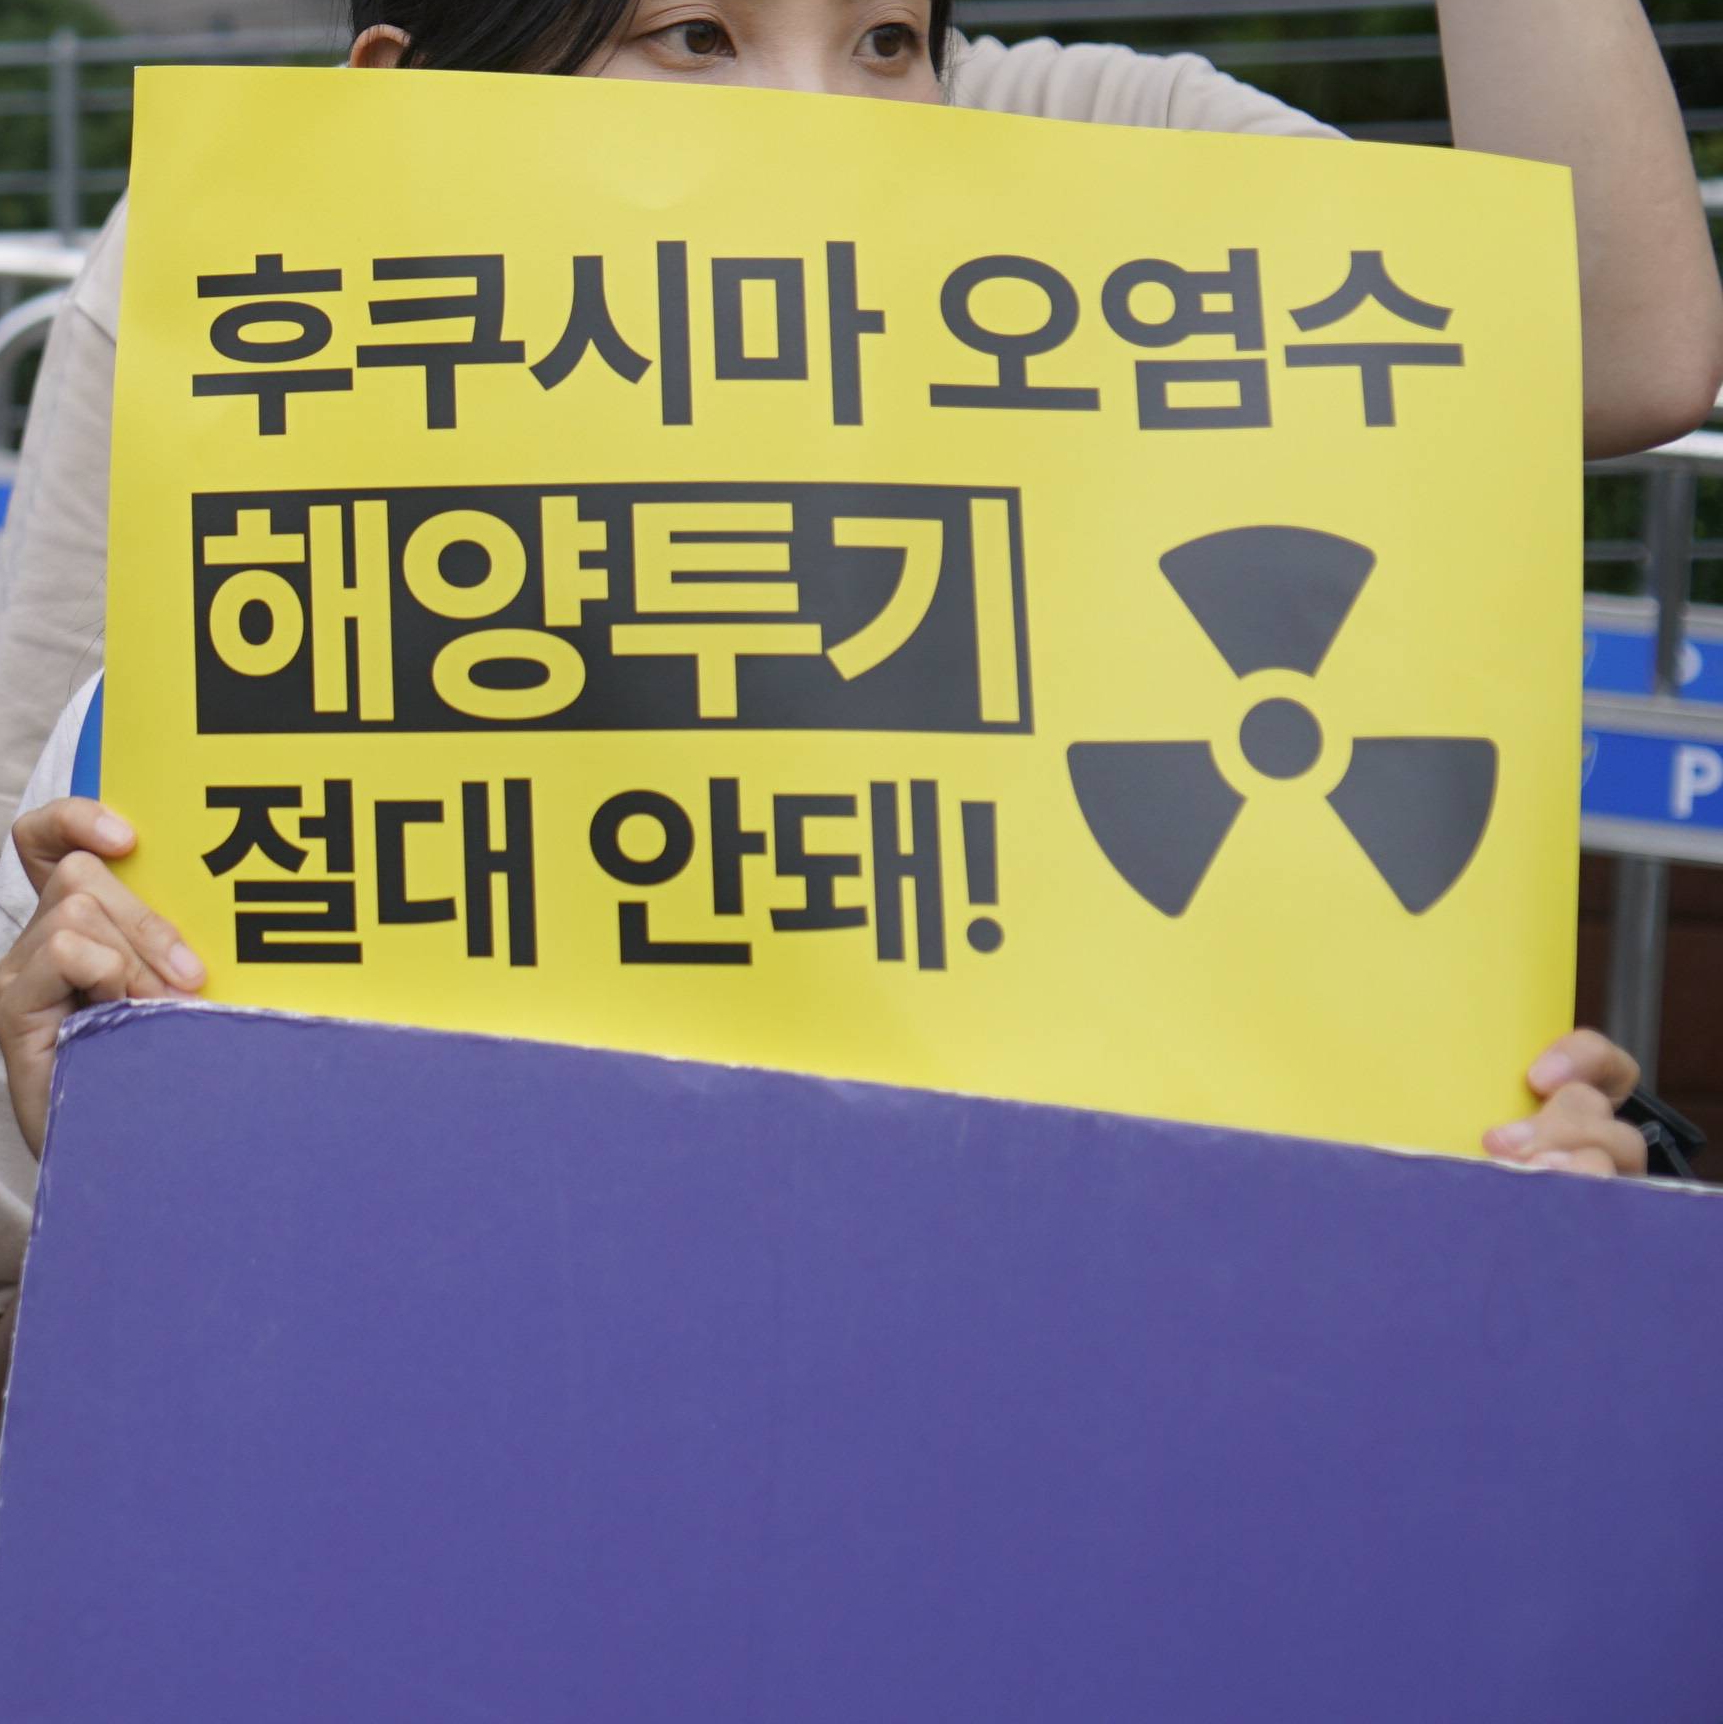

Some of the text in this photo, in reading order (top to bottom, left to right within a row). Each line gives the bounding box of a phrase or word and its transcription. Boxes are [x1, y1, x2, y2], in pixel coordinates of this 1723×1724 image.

[192, 241, 1466, 436] 후쿠시마 오염수
[201, 495, 1020, 724] 해양투기
[201, 776, 1004, 971] 절대 안돼!
